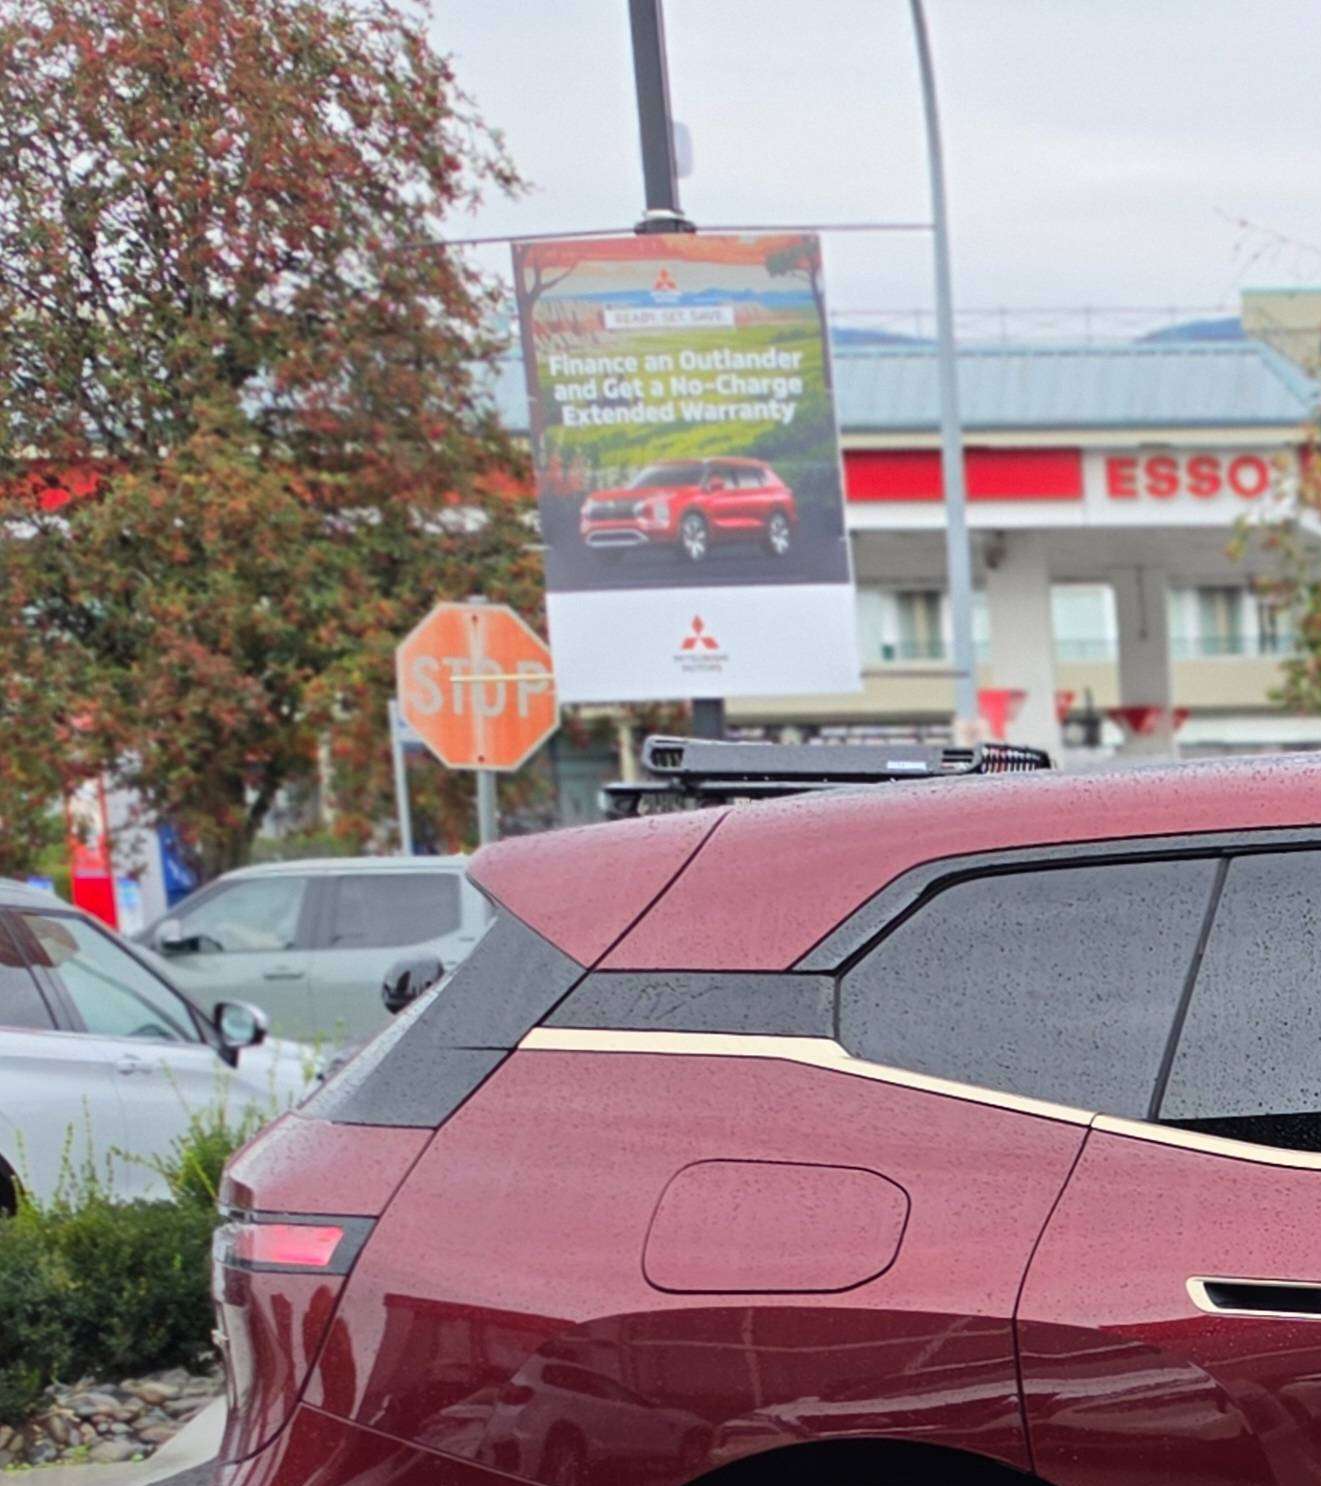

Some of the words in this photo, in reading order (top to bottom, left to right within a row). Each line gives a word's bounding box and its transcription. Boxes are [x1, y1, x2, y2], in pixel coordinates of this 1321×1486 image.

[549, 354, 638, 376] Finance
[644, 354, 674, 373] an
[679, 347, 802, 371] Outlander
[554, 380, 598, 401] and
[603, 378, 644, 400] Get
[650, 380, 665, 397] a
[669, 374, 803, 399] No-Charge
[561, 400, 675, 427] Extended
[680, 397, 797, 425] Warranty
[1106, 454, 1270, 499] ESSO
[411, 656, 549, 719] STOP
